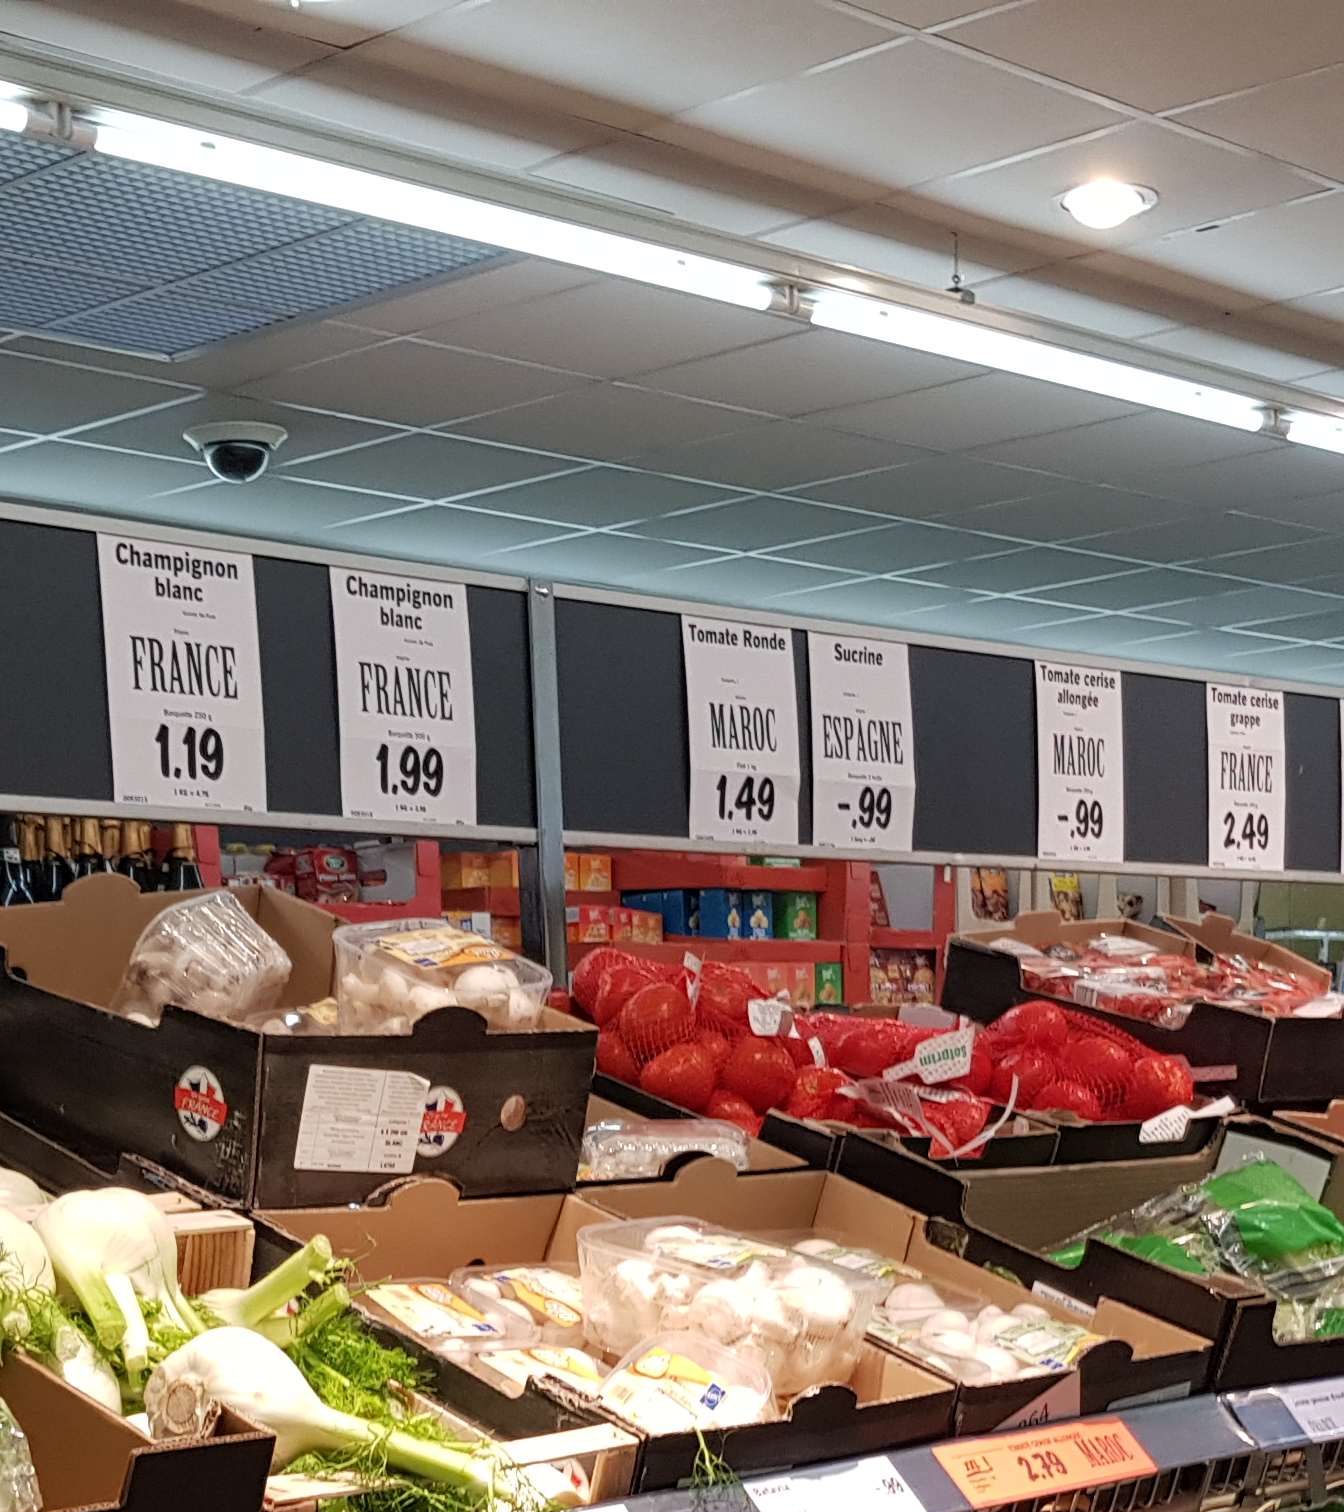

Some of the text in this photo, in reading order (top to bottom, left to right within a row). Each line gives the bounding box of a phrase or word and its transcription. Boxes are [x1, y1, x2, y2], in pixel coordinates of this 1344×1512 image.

[116, 542, 239, 581] Champignon
[154, 576, 204, 603] blanc
[346, 575, 454, 610] Champignon
[380, 606, 423, 631] blanc
[688, 624, 786, 651] Tomate Ronde
[129, 635, 239, 701] FRANCE
[834, 644, 884, 668] Sucrine
[358, 661, 454, 722] FRANCE
[1041, 665, 1116, 690] Tomate cerise
[1057, 690, 1099, 710] allongée
[1211, 687, 1279, 710] Tomate cerise
[709, 702, 778, 752] MAROC
[822, 714, 904, 765] ESPAGNE
[1230, 713, 1261, 729] grappe
[155, 723, 224, 781] 1.19
[376, 743, 444, 797] 1.99
[1053, 732, 1105, 779] MAROC
[1220, 750, 1274, 794] FRANCE
[716, 775, 775, 822] 1.49
[1223, 811, 1269, 851] 2.49
[919, 1043, 968, 1068] Solprim
[180, 1096, 219, 1119] FRANCE
[1016, 1451, 1068, 1484] 2.79
[1073, 1433, 1135, 1470] MAROC
